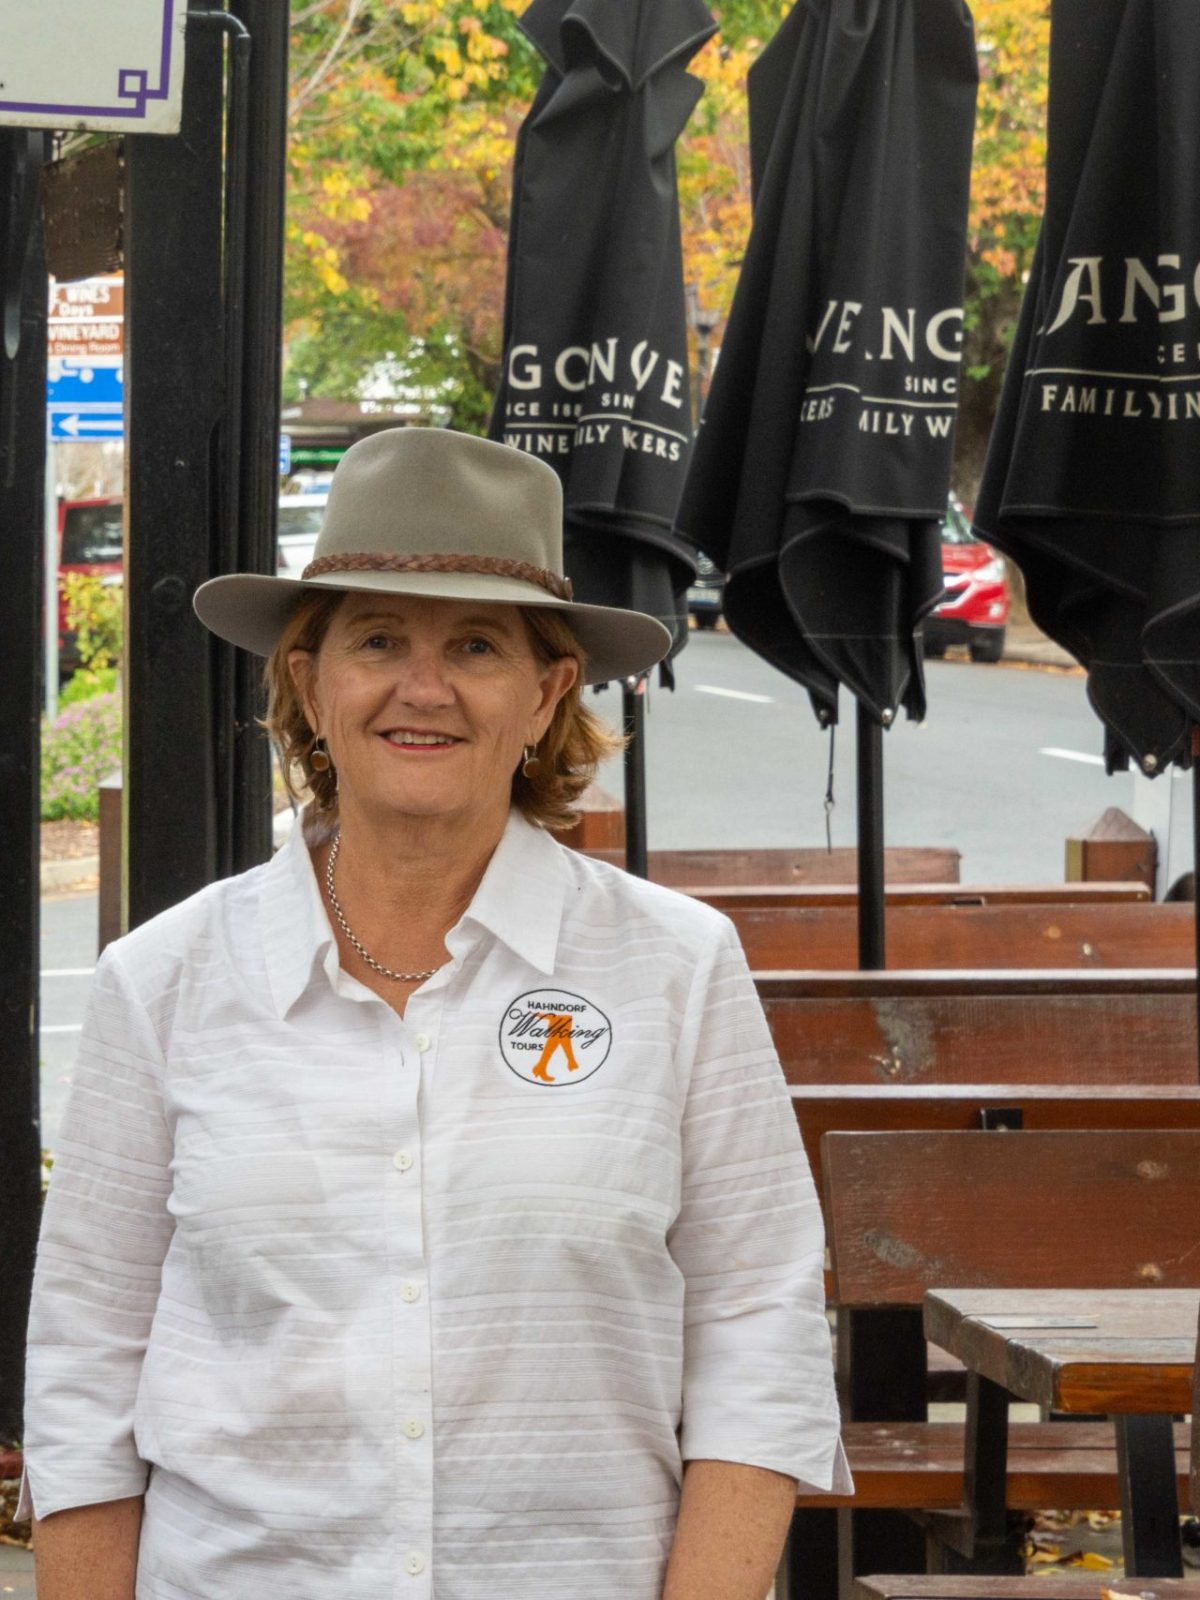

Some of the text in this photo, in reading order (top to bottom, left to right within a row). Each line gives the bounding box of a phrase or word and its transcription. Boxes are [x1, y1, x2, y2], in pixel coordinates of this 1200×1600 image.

[527, 1001, 587, 1013] HAHNDORF
[508, 1008, 611, 1050] Walking
[510, 1041, 544, 1051] TOURS
